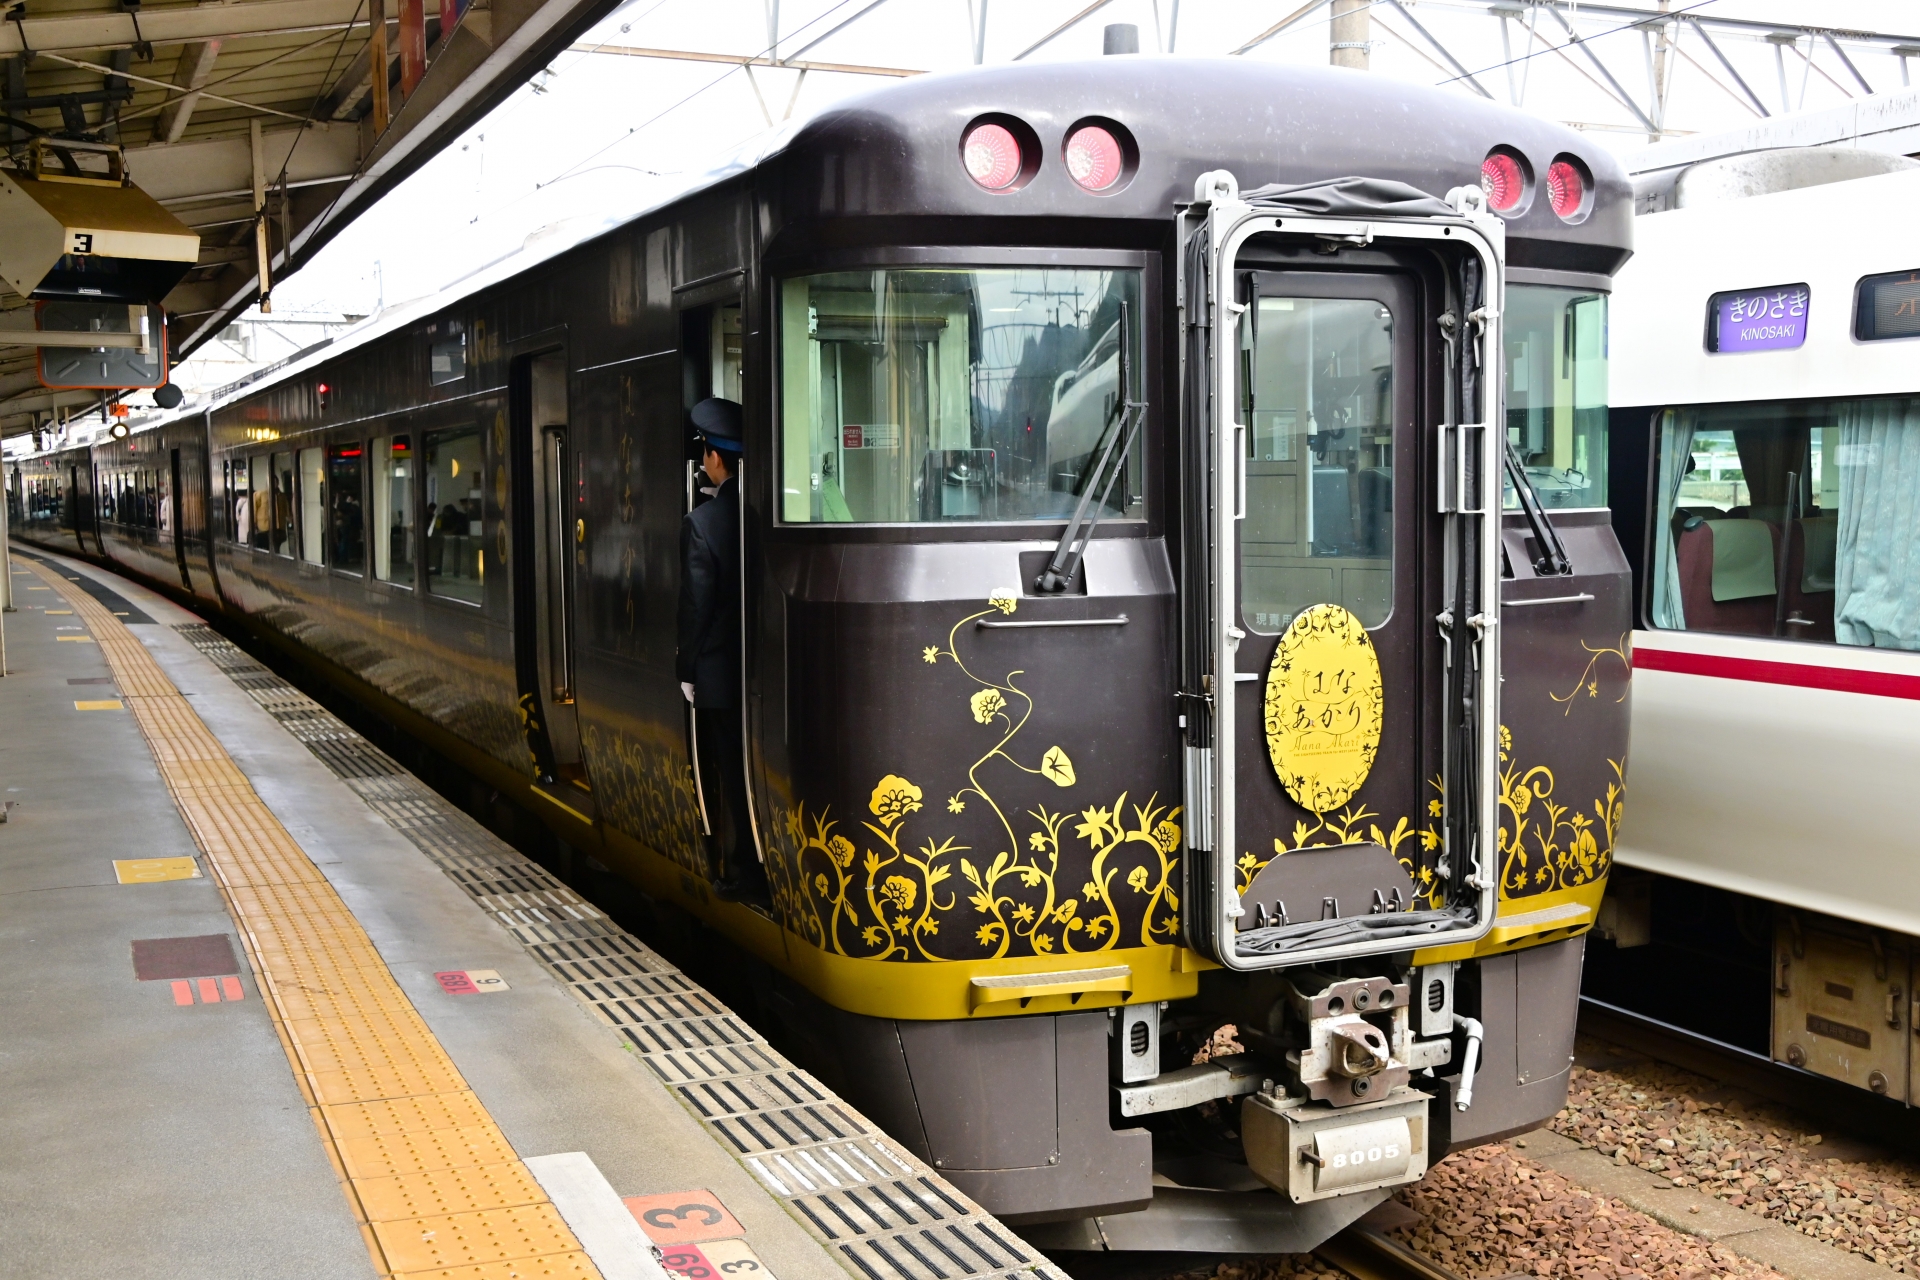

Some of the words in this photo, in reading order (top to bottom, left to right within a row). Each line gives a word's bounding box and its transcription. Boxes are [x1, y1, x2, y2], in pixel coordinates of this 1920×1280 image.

[73, 233, 93, 253] 3
[1729, 289, 1808, 324] きのさき
[1740, 324, 1796, 341] KINOSAKI
[1303, 669, 1356, 700] はな
[1292, 700, 1361, 729] あかり
[440, 974, 472, 992] 189
[1332, 1144, 1400, 1168] 8005
[643, 1203, 723, 1229] 3
[720, 1259, 759, 1274] 3
